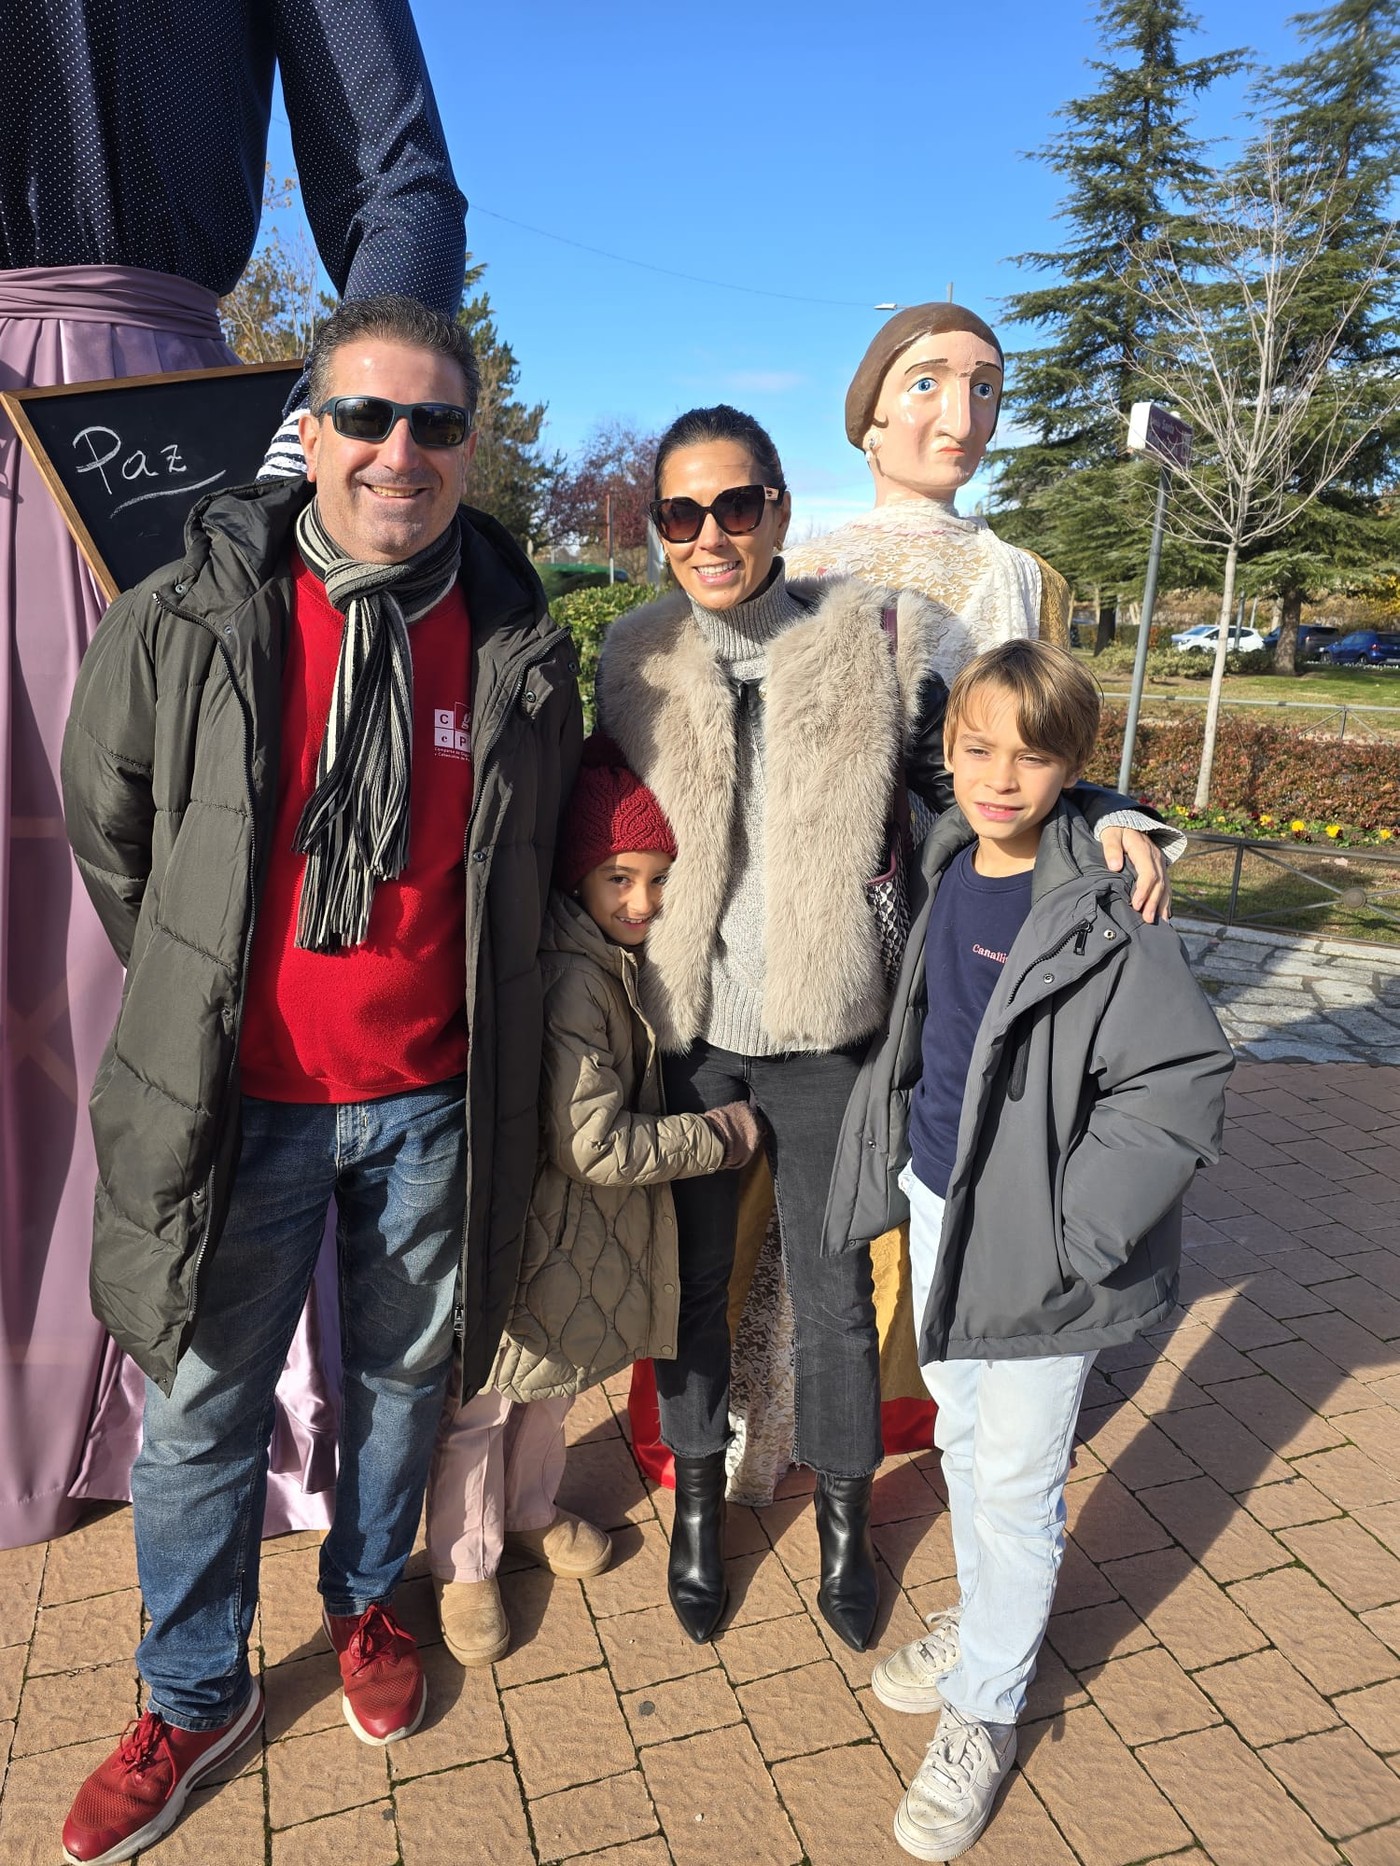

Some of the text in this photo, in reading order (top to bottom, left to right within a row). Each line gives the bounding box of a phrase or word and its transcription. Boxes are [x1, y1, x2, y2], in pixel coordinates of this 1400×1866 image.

[72, 425, 187, 495] Paz
[439, 713, 449, 725] C
[459, 736, 467, 747] P
